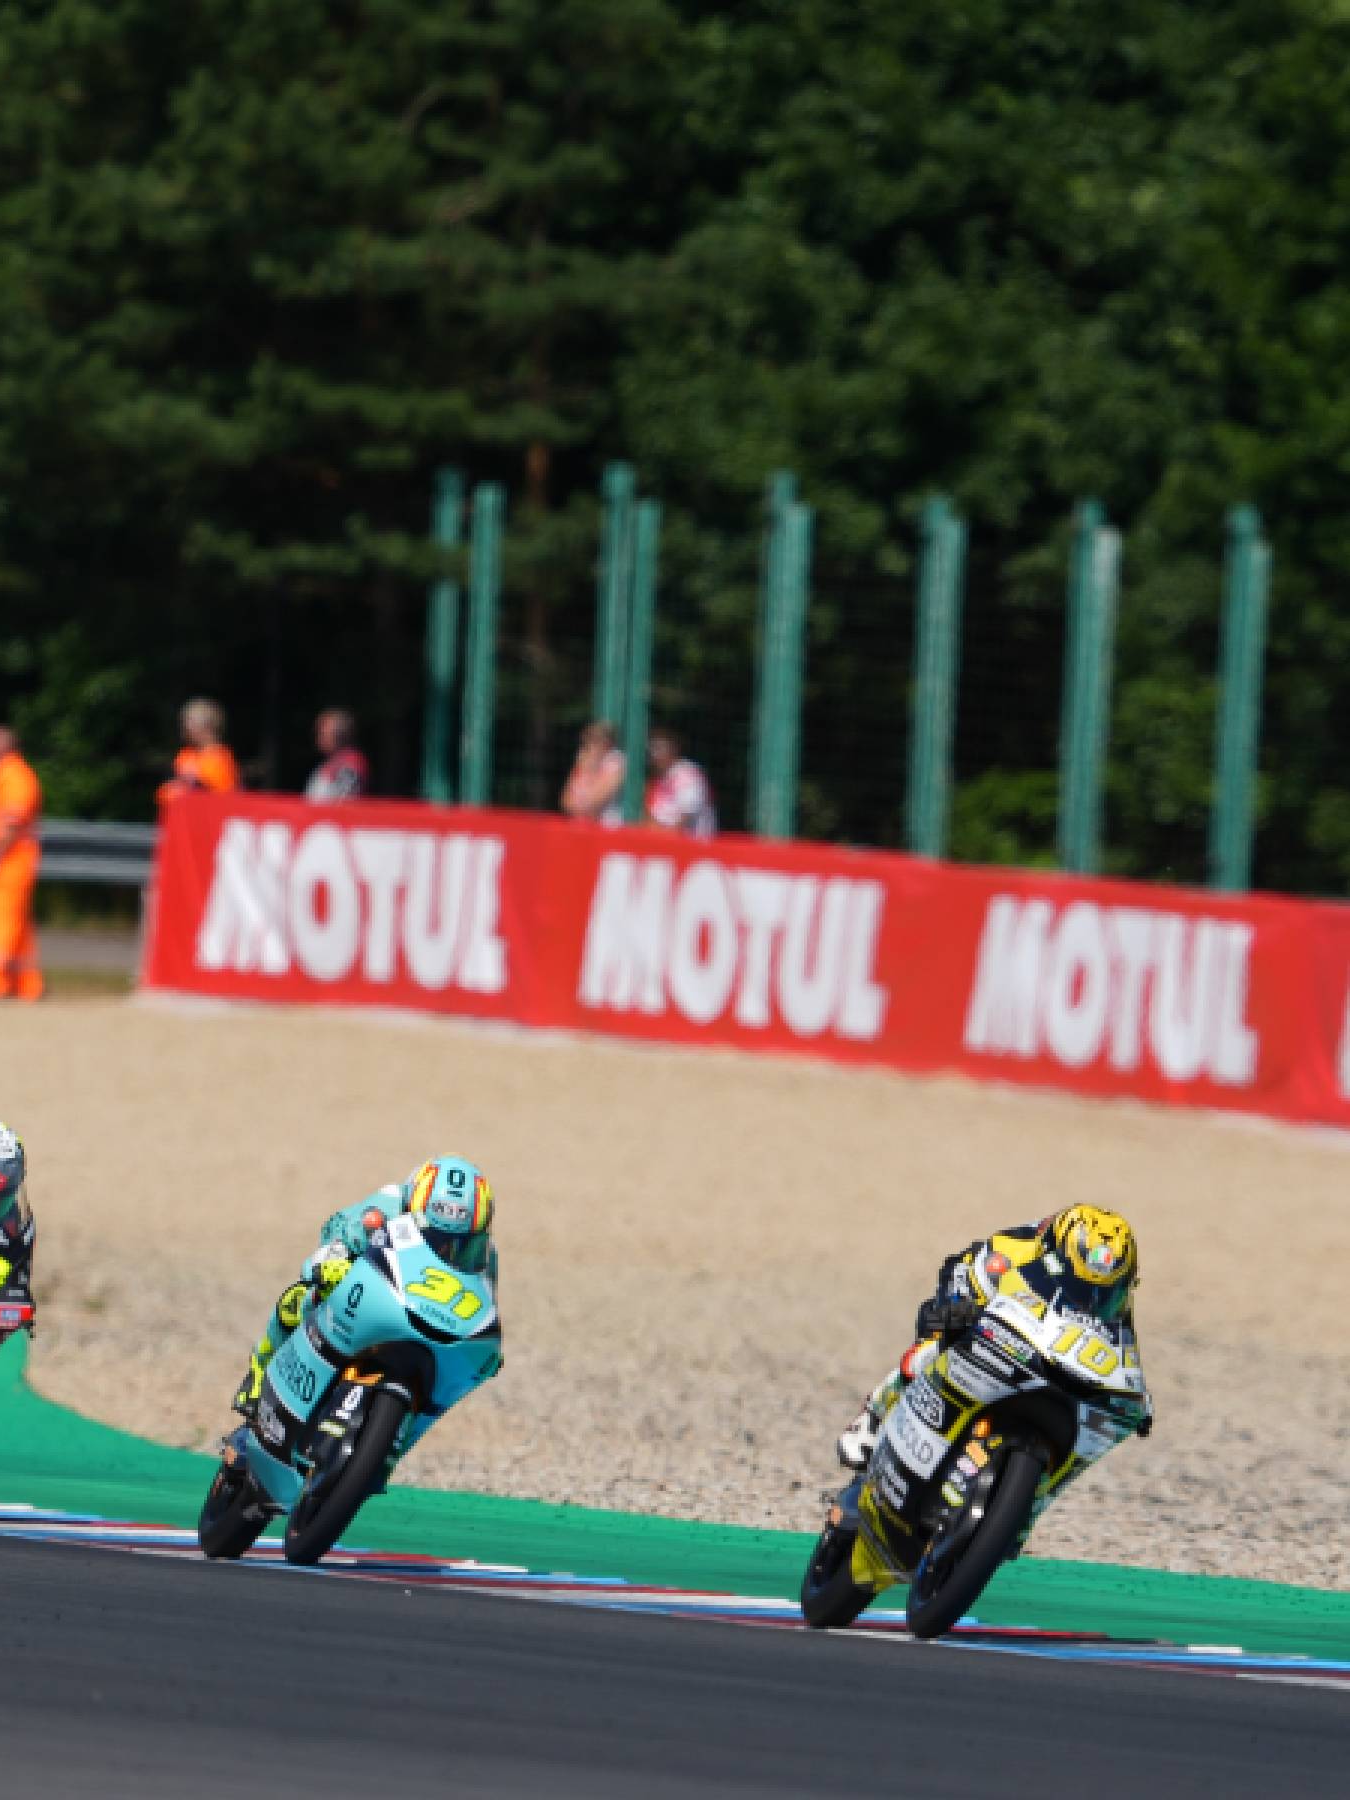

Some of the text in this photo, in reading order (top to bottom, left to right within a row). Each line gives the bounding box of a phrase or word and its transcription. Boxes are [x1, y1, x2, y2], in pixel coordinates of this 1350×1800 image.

[196, 818, 508, 993] MOTUL
[579, 853, 888, 1040] MOTUL
[963, 894, 1259, 1087] MOTUL
[405, 1267, 482, 1320] 31
[1053, 1324, 1119, 1377] 10
